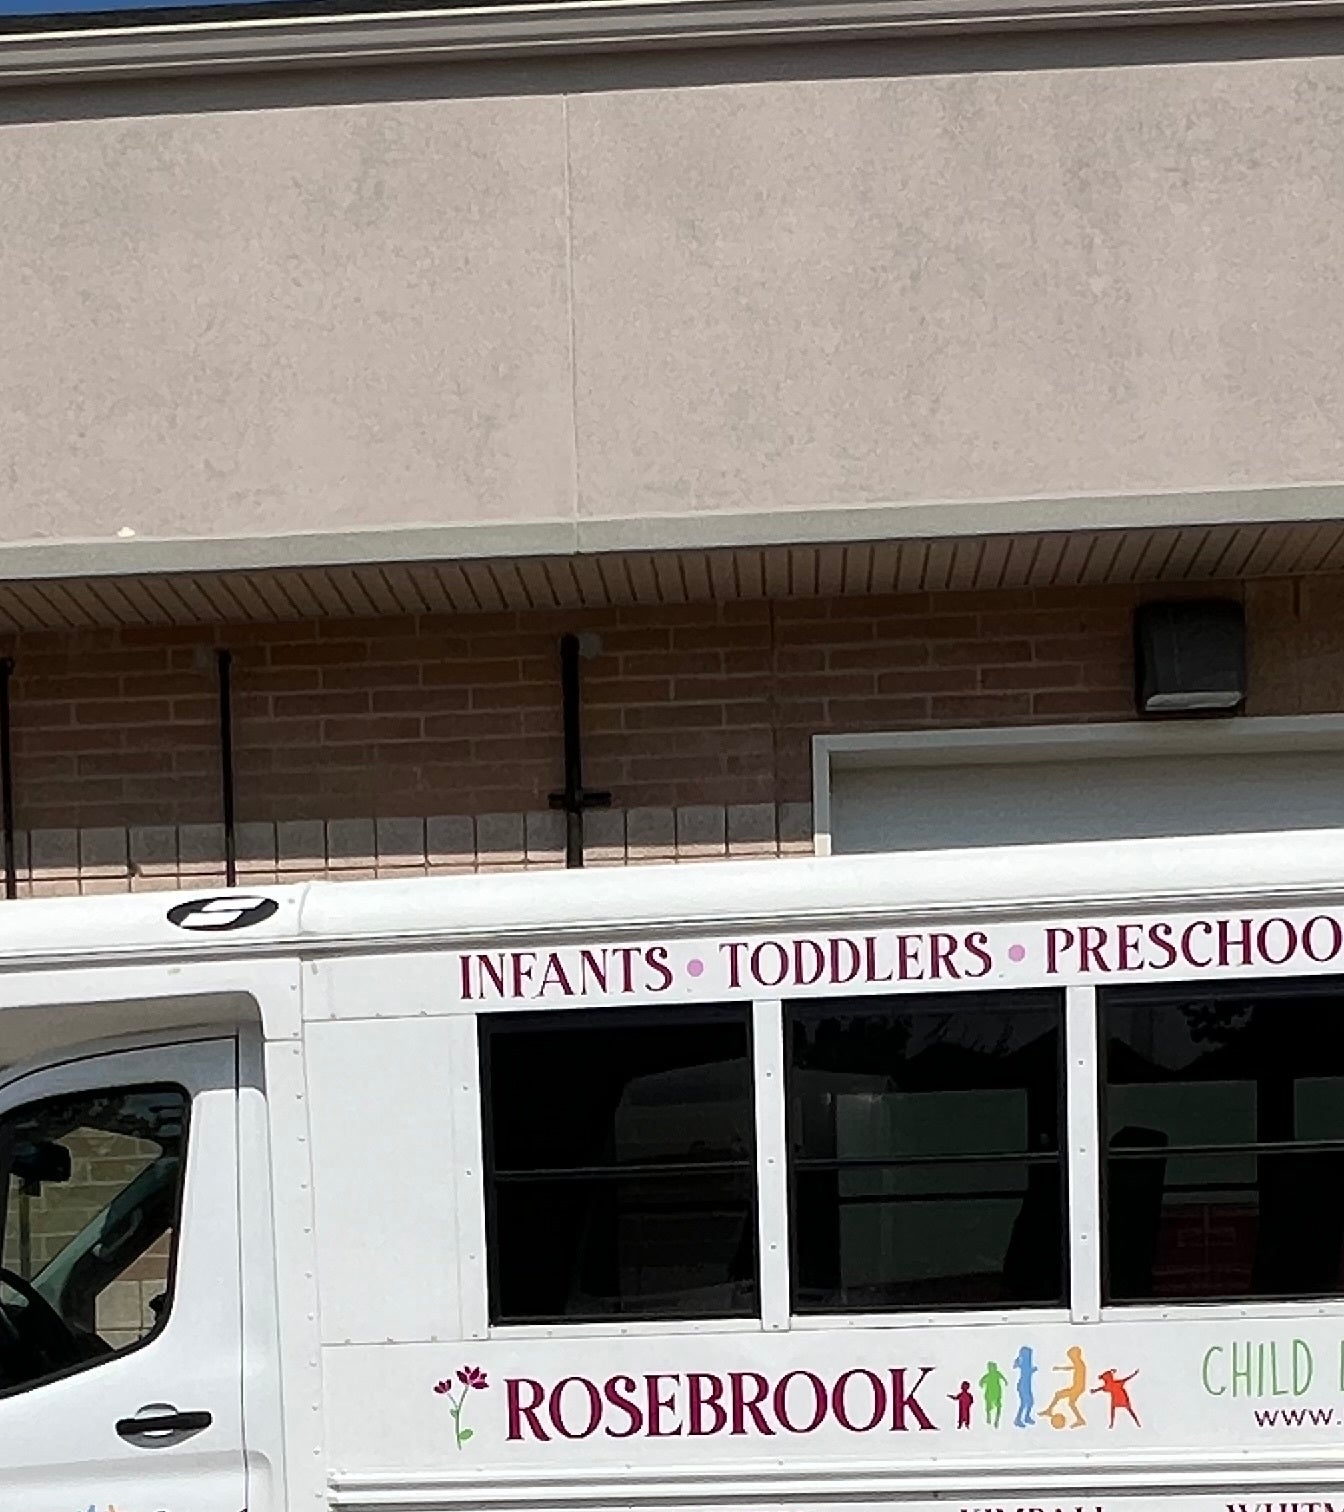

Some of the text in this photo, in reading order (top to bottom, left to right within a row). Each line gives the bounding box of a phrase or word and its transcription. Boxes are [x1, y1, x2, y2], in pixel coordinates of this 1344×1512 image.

[460, 947, 674, 1000] INFANTS
[719, 931, 993, 988] TODDLERS
[1203, 1339, 1312, 1397] CHILD
[505, 1367, 937, 1441] ROSEBROOK
